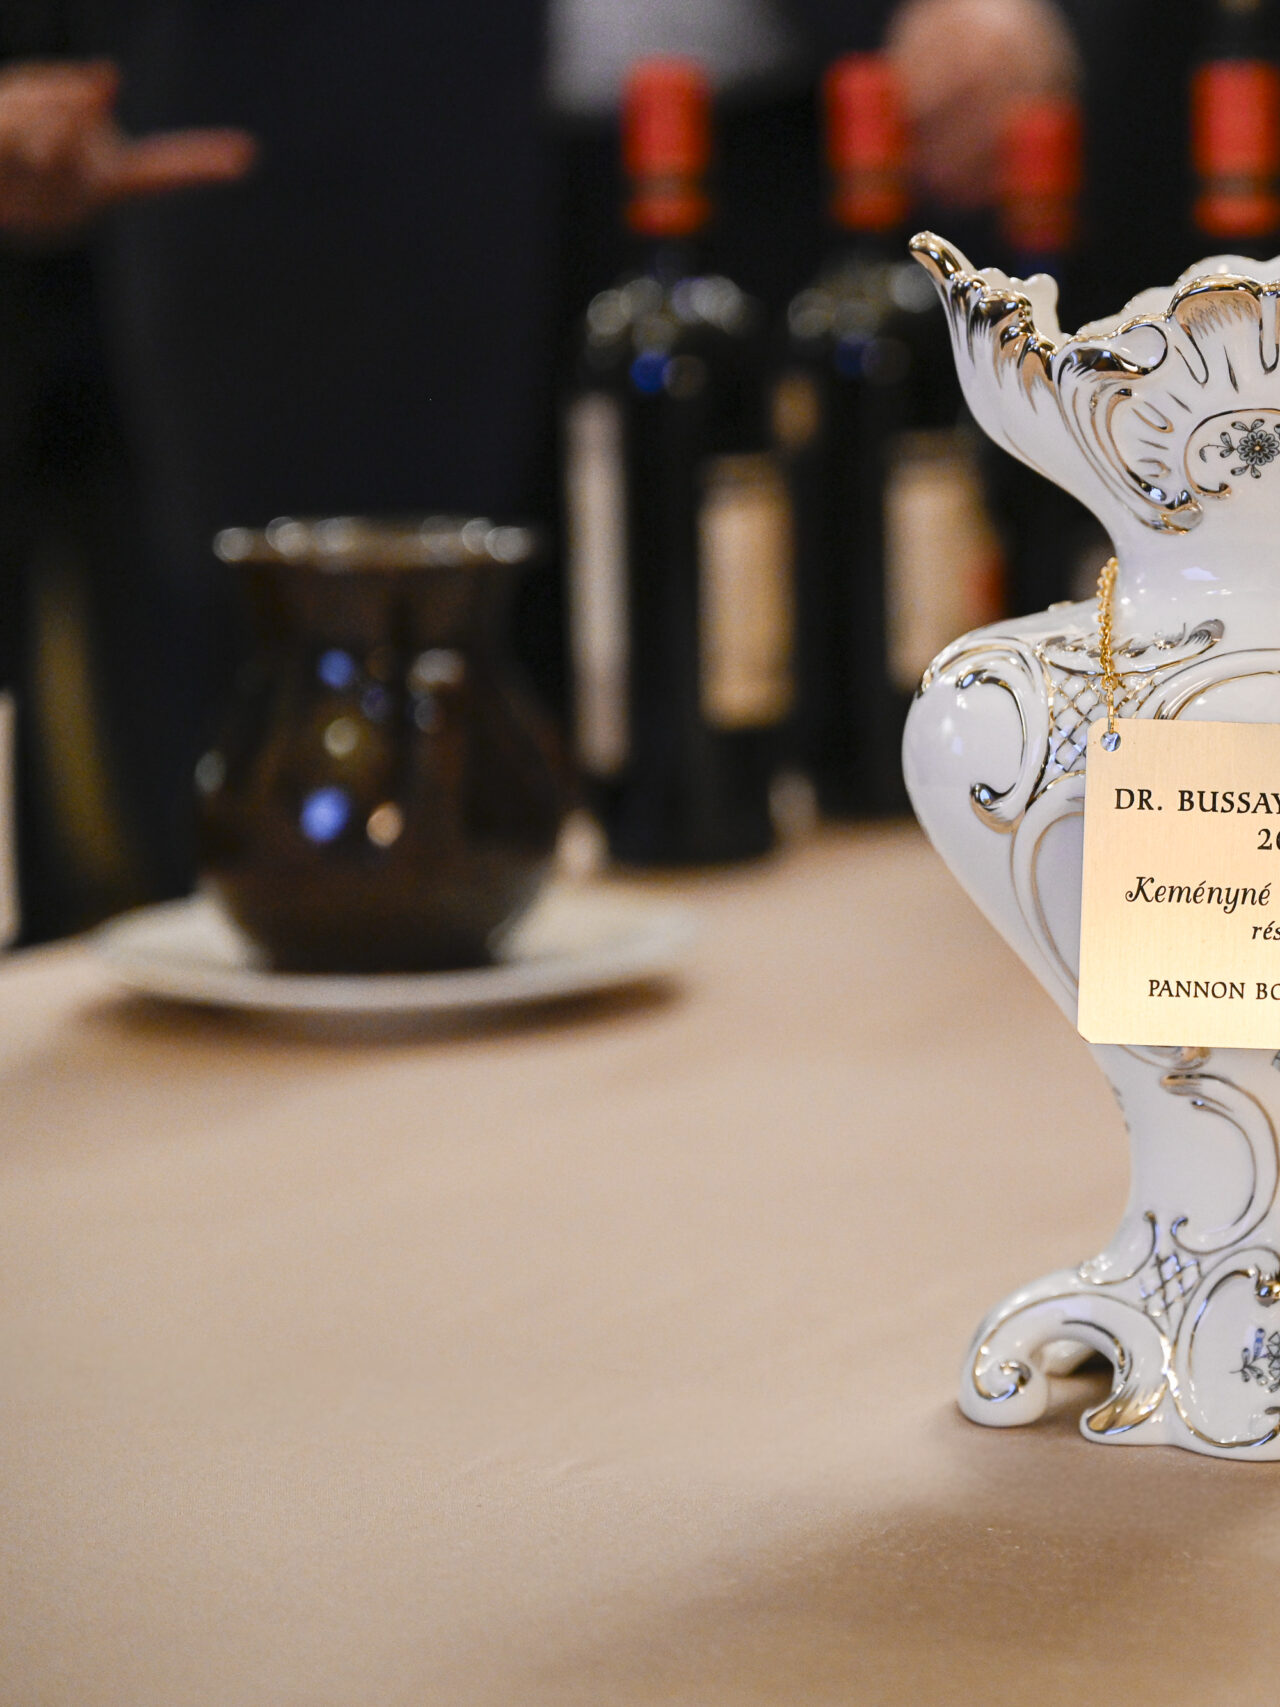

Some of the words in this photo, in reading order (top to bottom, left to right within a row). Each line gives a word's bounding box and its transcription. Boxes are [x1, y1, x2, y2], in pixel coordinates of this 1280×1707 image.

[1114, 787, 1163, 812] DR.
[1124, 876, 1272, 915] Keményné
[1147, 979, 1246, 1000] PANNON
